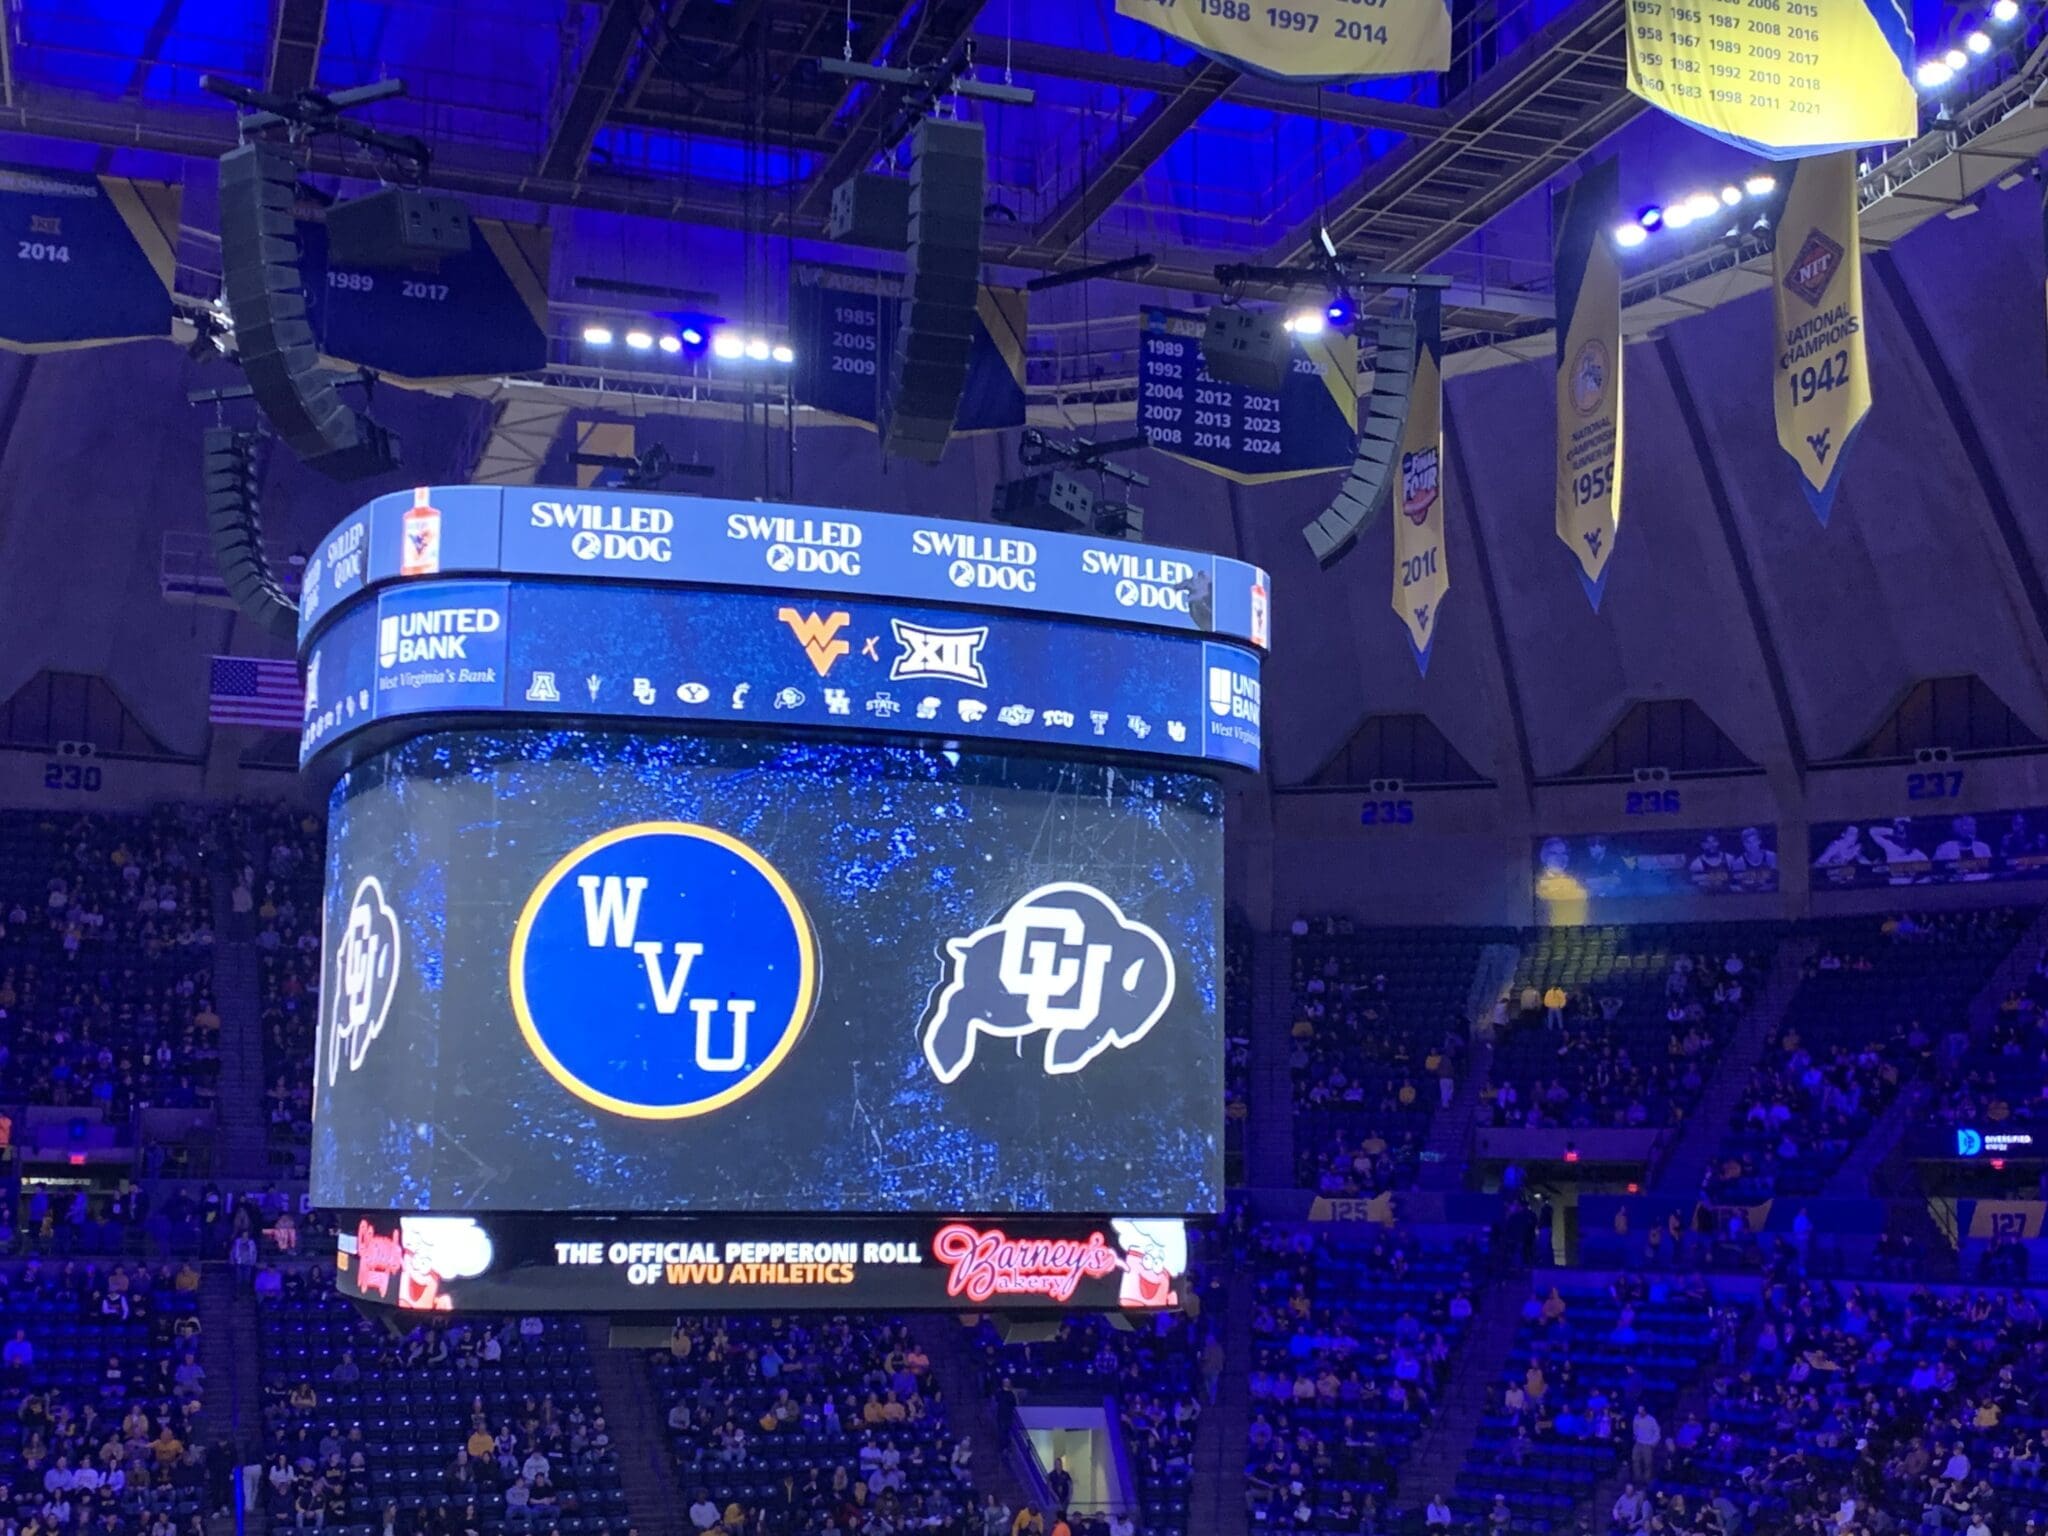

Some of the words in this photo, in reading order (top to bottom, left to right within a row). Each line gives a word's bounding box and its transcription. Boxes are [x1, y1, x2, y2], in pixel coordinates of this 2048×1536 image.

[1200, 0, 1251, 22] 1988
[1266, 8, 1319, 33] 1997
[1334, 19, 1388, 45] 2014
[1632, 1, 1662, 16] 1957
[1670, 7, 1701, 23] 1965
[1709, 14, 1740, 29] 1987
[1748, 20, 1781, 36] 2008
[1787, 26, 1819, 42] 2016
[1786, 2, 1818, 17] 2015
[1637, 26, 1663, 42] 958
[1670, 32, 1700, 47] 1967
[1709, 39, 1741, 54] 1989
[1748, 45, 1781, 60] 2009
[1788, 51, 1819, 66] 2017
[1639, 52, 1663, 66] 959
[1709, 64, 1741, 79] 1992
[1749, 70, 1781, 85] 2010
[1788, 75, 1820, 90] 2018
[1637, 73, 1664, 91] 160
[1709, 89, 1742, 104] 1998
[1750, 95, 1780, 110] 2011
[1789, 101, 1821, 116] 2021
[18, 241, 70, 263] 2014
[1798, 252, 1831, 284] NIT
[327, 271, 373, 291] 1989
[402, 280, 449, 300] 2017
[834, 307, 876, 326] 1985
[832, 332, 876, 351] 2005
[1147, 340, 1184, 357] 1989
[831, 356, 876, 375] 2009
[1147, 361, 1183, 380] 1992
[1789, 349, 1850, 407] 1942
[1145, 383, 1184, 401] 2004
[1195, 389, 1232, 408] 2012
[1243, 395, 1280, 412] 2021
[1144, 404, 1182, 422] 2007
[1194, 411, 1231, 428] 2013
[1243, 417, 1281, 433] 2023
[1144, 426, 1182, 444] 2008
[1194, 432, 1232, 450] 2014
[1243, 438, 1282, 455] 2024
[531, 501, 674, 535] SWILLED
[727, 513, 863, 549] SWILLED
[604, 534, 673, 563] DOG
[797, 546, 862, 577] DOG
[912, 529, 1038, 566] SWILLED
[977, 564, 1037, 593] DOG
[1082, 548, 1194, 585] SWILLED
[400, 608, 501, 637] UNITED
[400, 634, 468, 665] BANK
[457, 666, 497, 684] Bank
[44, 763, 102, 792] 230
[1906, 771, 1964, 799] 237
[1361, 799, 1414, 825] 235
[1625, 790, 1681, 815] 236
[999, 906, 1113, 1030] CU
[1331, 1201, 1369, 1222] 125
[1991, 1213, 2027, 1239] 127
[554, 1242, 603, 1265] THE
[608, 1242, 720, 1265] OFFICIAL
[725, 1242, 858, 1265] PEPPERONI
[863, 1242, 922, 1265] ROLL
[937, 1227, 1105, 1296] Barney's
[627, 1264, 661, 1286] OF
[666, 1263, 724, 1285] WVU
[728, 1263, 855, 1285] ATHLETICS
